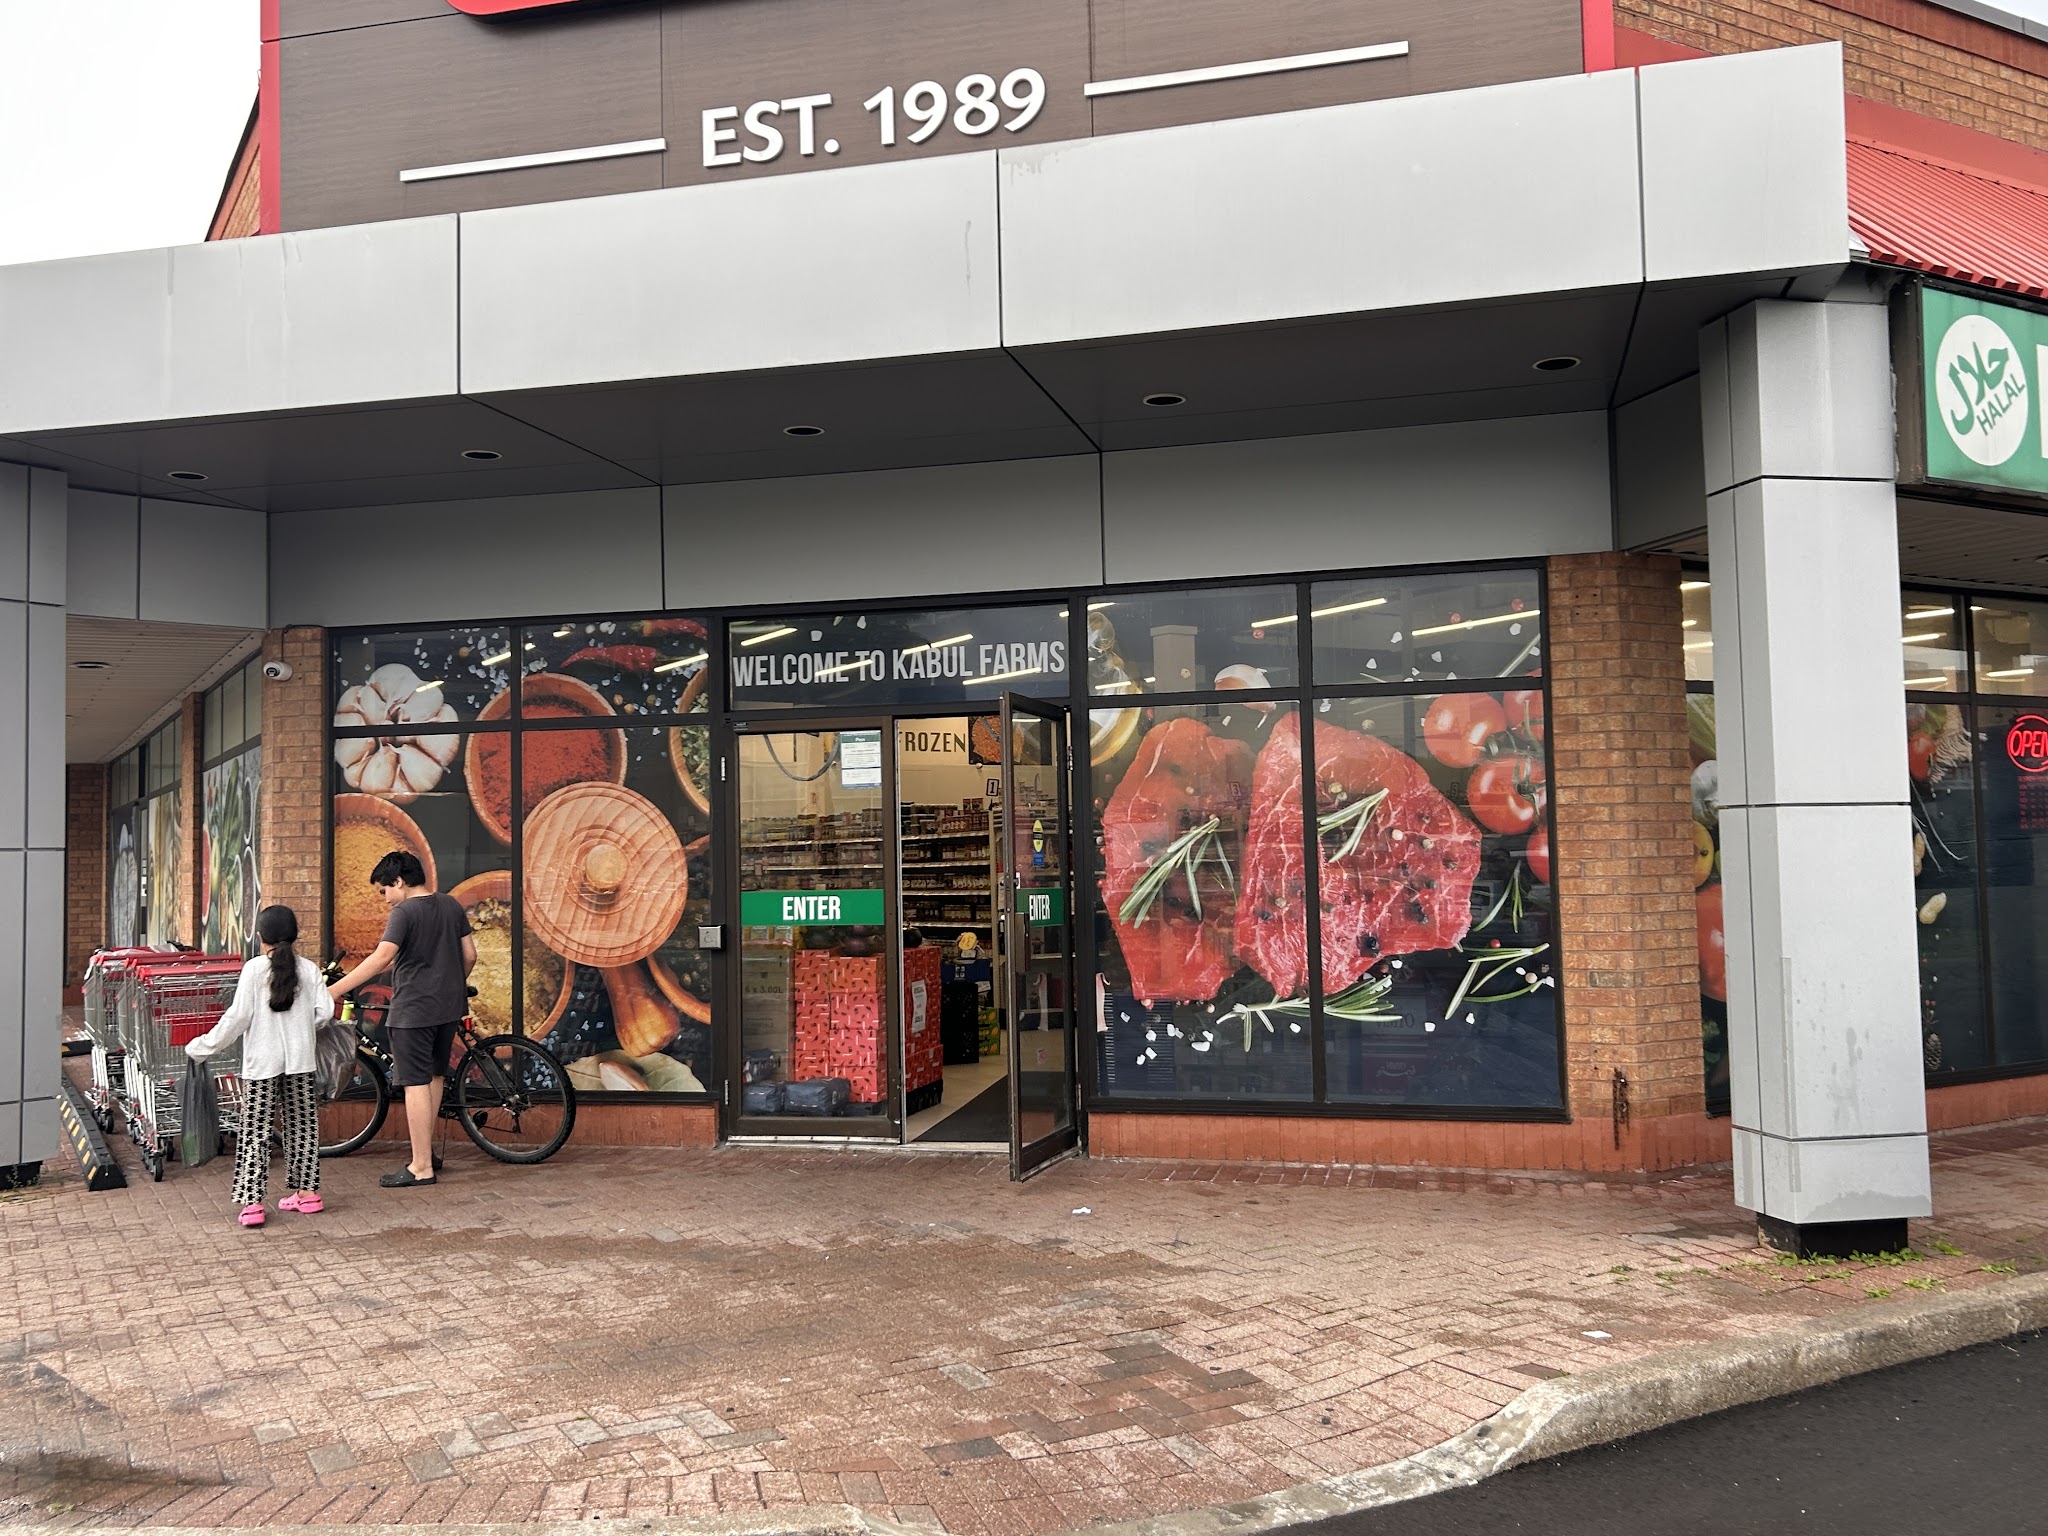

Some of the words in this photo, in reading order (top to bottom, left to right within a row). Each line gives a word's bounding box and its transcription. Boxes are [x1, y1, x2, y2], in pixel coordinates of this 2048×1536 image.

[702, 93, 840, 168] EST.
[863, 67, 1046, 146] 1989
[1976, 373, 2026, 436] HALAL
[733, 651, 849, 687] WELCOME
[855, 649, 886, 682] TO
[892, 646, 973, 681] KABUL
[979, 640, 1066, 675] FARMS
[782, 896, 842, 920] ENTER
[1029, 894, 1051, 920] ENTER
